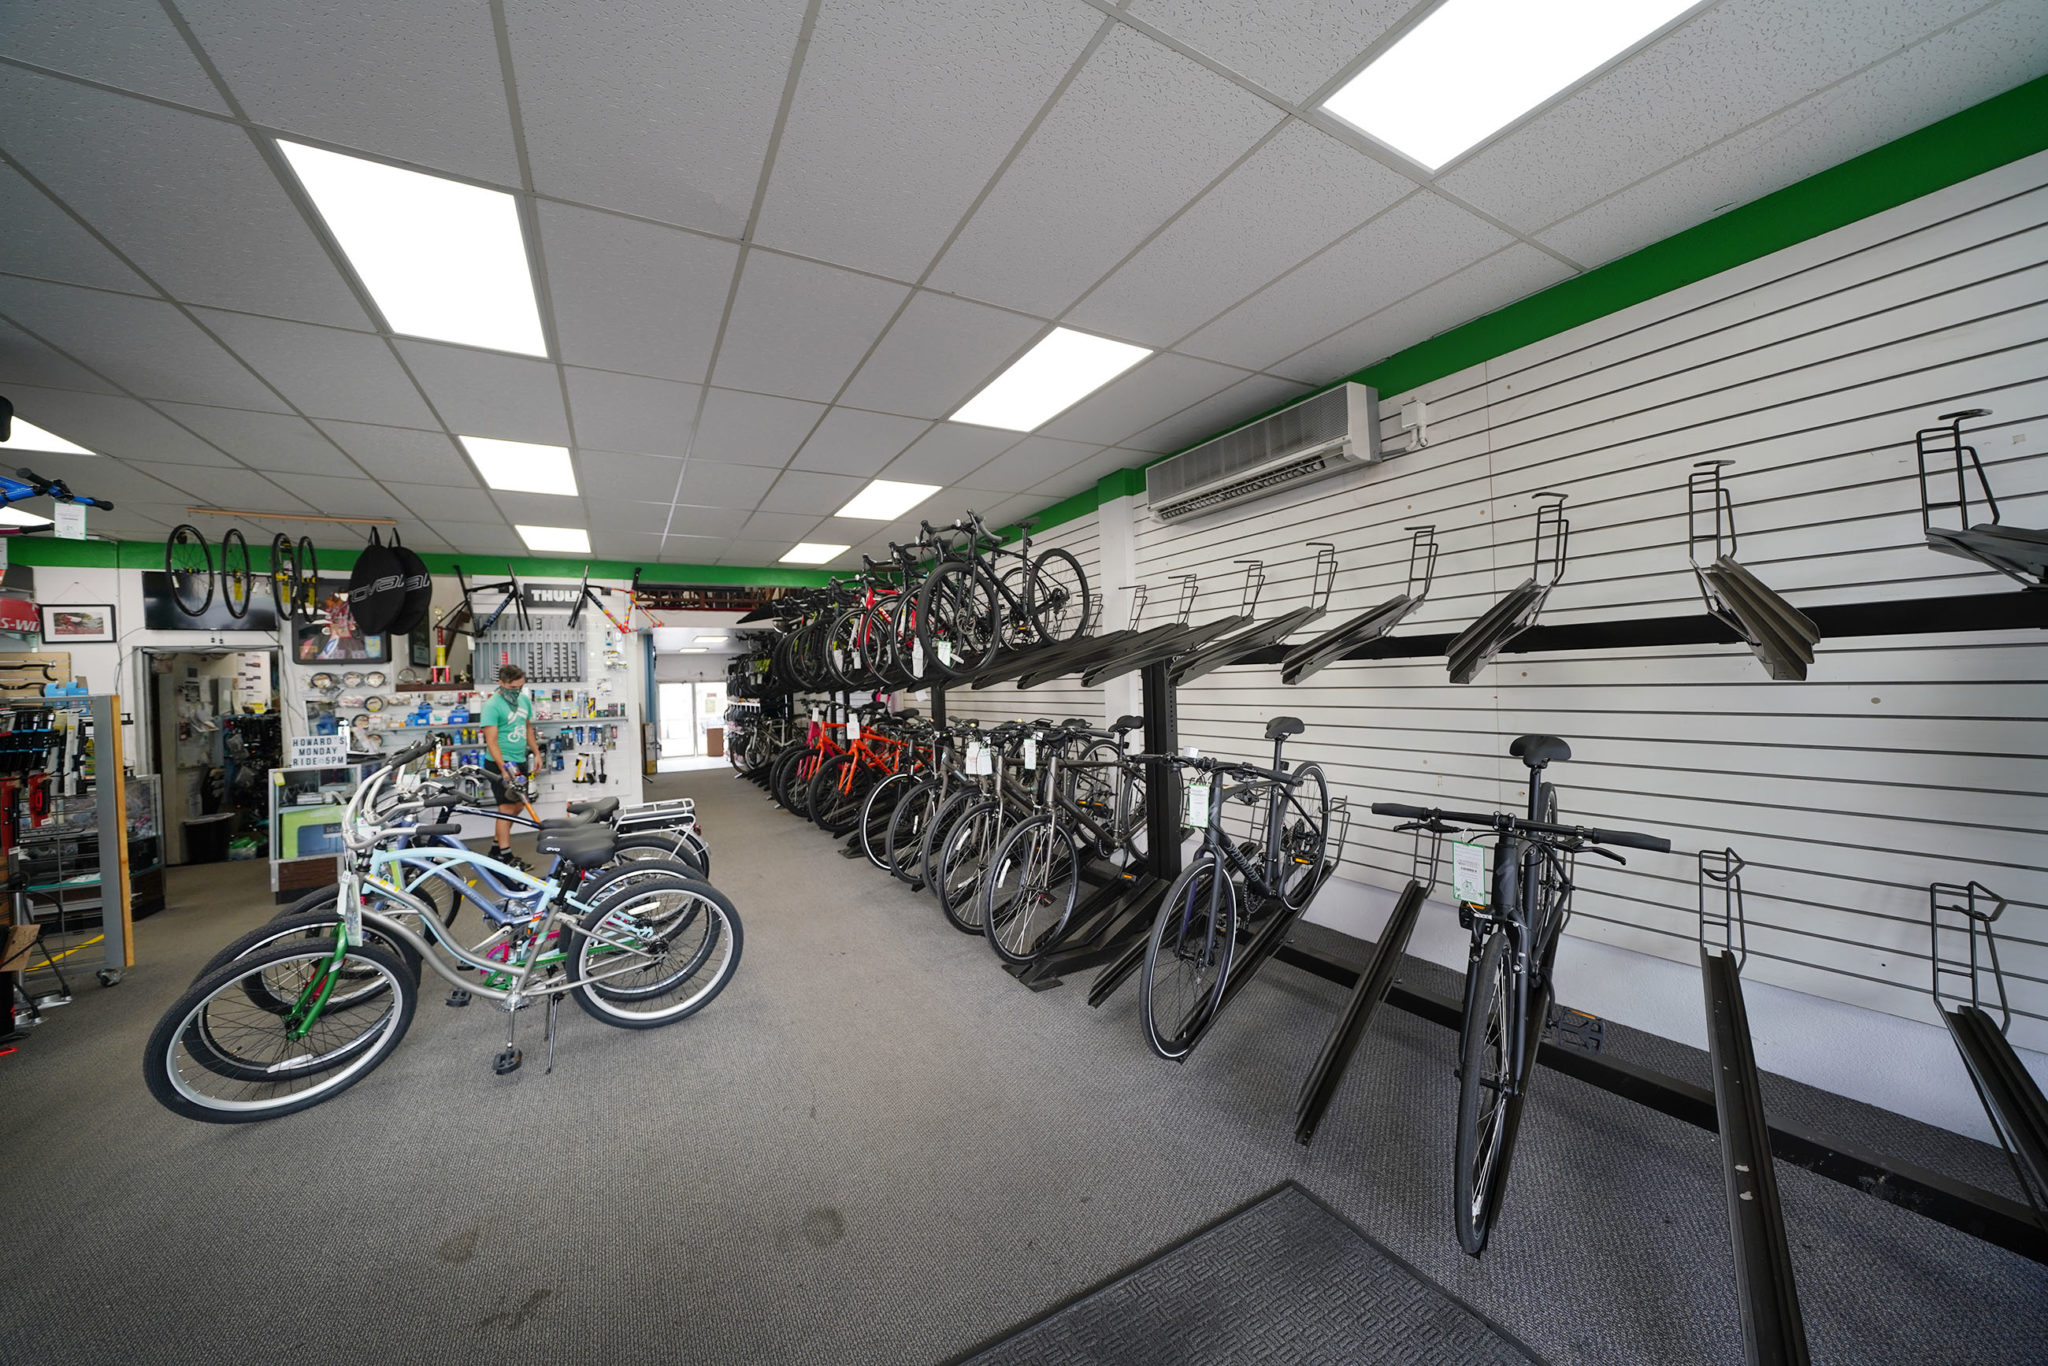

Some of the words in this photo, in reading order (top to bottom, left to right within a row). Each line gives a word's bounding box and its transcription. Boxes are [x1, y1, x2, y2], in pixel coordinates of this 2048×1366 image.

[349, 574, 404, 602] oval
[299, 747, 337, 756] MONDAY
[293, 758, 318, 766] RIDE
[325, 756, 344, 765] 5PM
